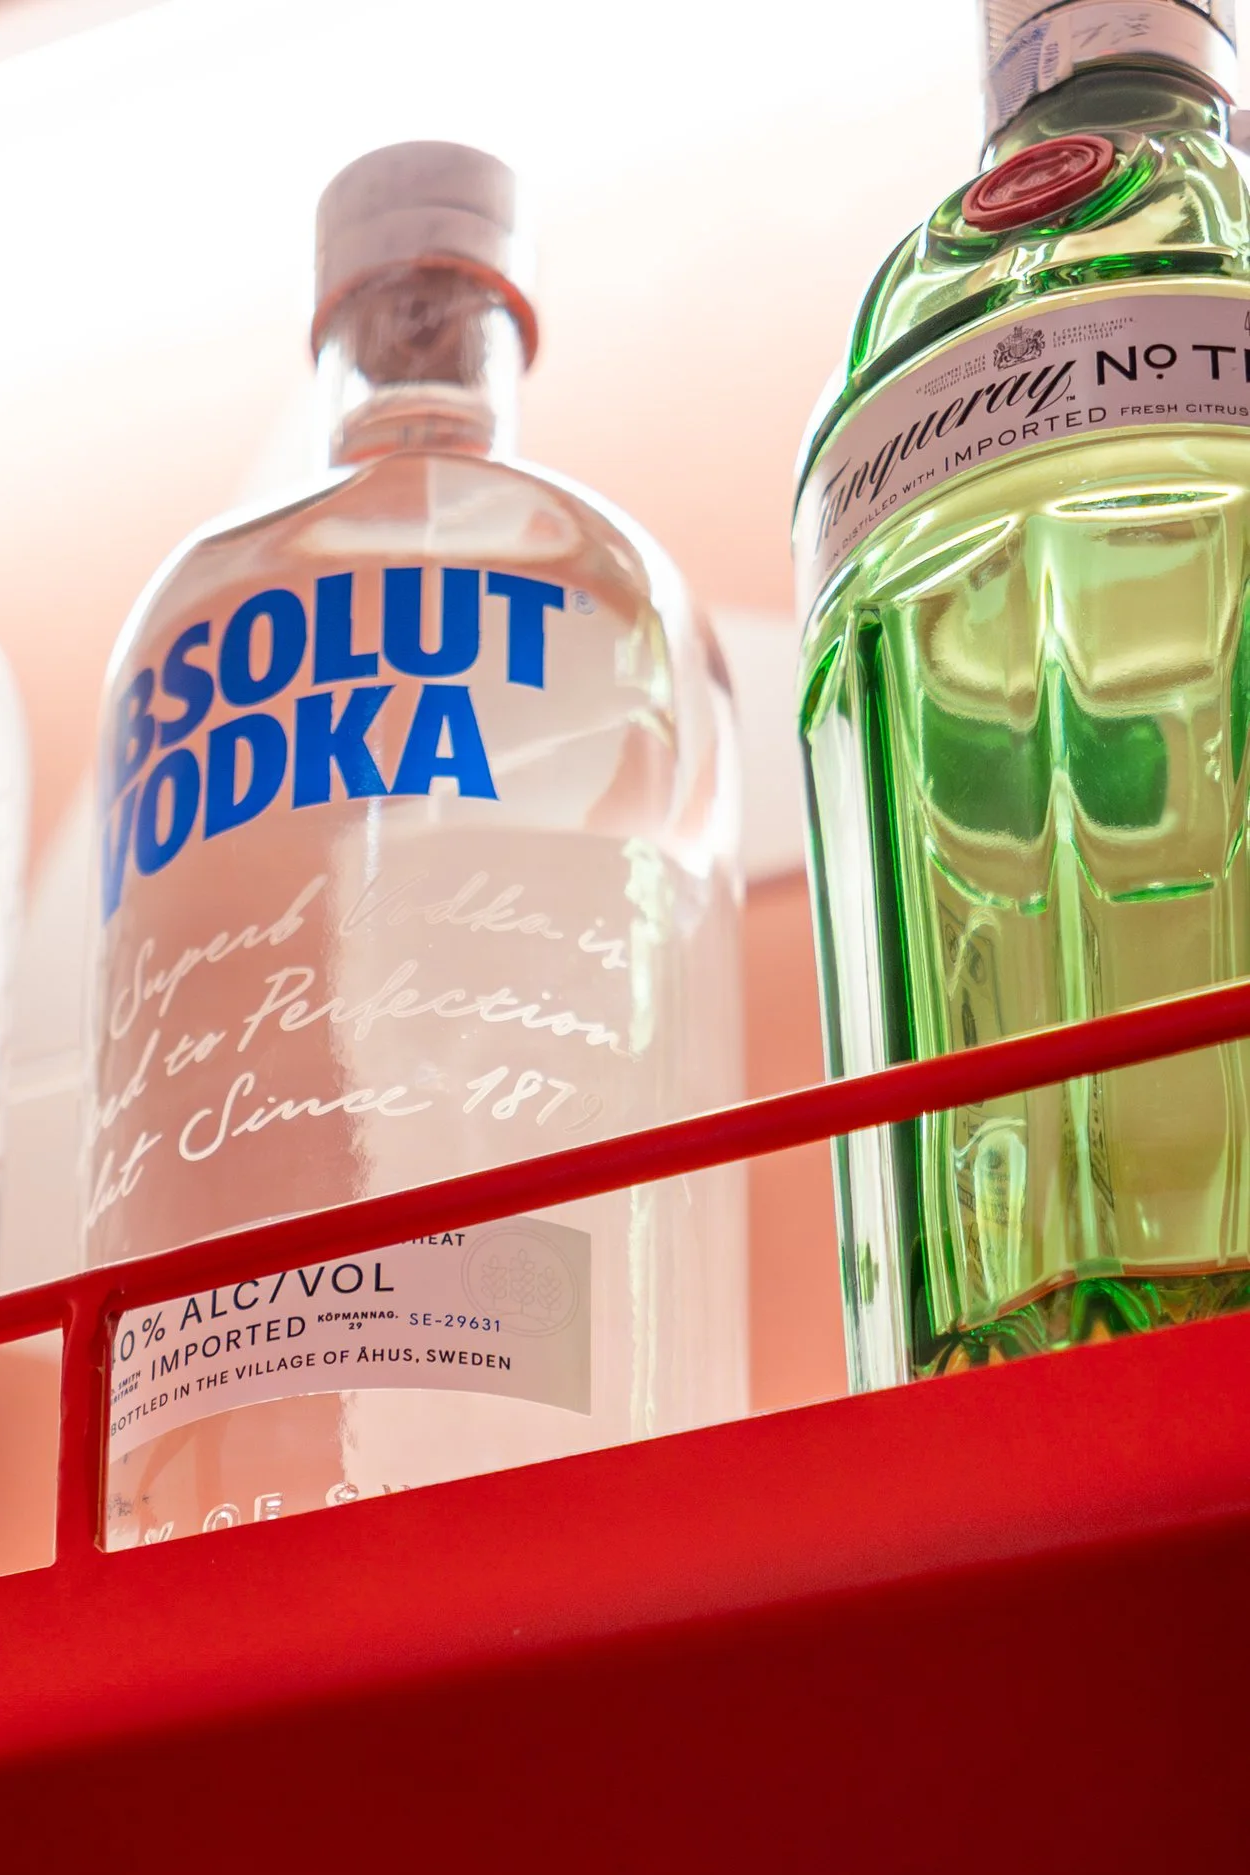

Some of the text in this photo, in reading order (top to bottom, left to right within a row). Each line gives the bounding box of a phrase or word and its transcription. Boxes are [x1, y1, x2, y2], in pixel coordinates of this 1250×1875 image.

[814, 359, 1077, 555] Tanqueray
[842, 493, 898, 550] DISTILLED
[901, 468, 936, 495] WITH
[944, 406, 1107, 472] IMPORTED
[1120, 403, 1178, 417] FRESH
[1186, 403, 1250, 417] CITRUS
[100, 683, 501, 928] VODKA
[110, 870, 629, 1040] Superb Vodka is
[163, 1029, 228, 1077] to
[236, 959, 632, 1053] Perfection
[179, 1071, 434, 1162] Since
[462, 1066, 605, 1134] 1879
[179, 1262, 395, 1332] ALC/VOL
[317, 1309, 399, 1323] KÖPMANNAG.
[348, 1321, 363, 1331] 29
[408, 1312, 501, 1333] SE-29631
[110, 1346, 512, 1437] BOTTLED IN THE VILLAGE OF ÅHUS, SWEDEN
[150, 1314, 306, 1382] IMPORTED
